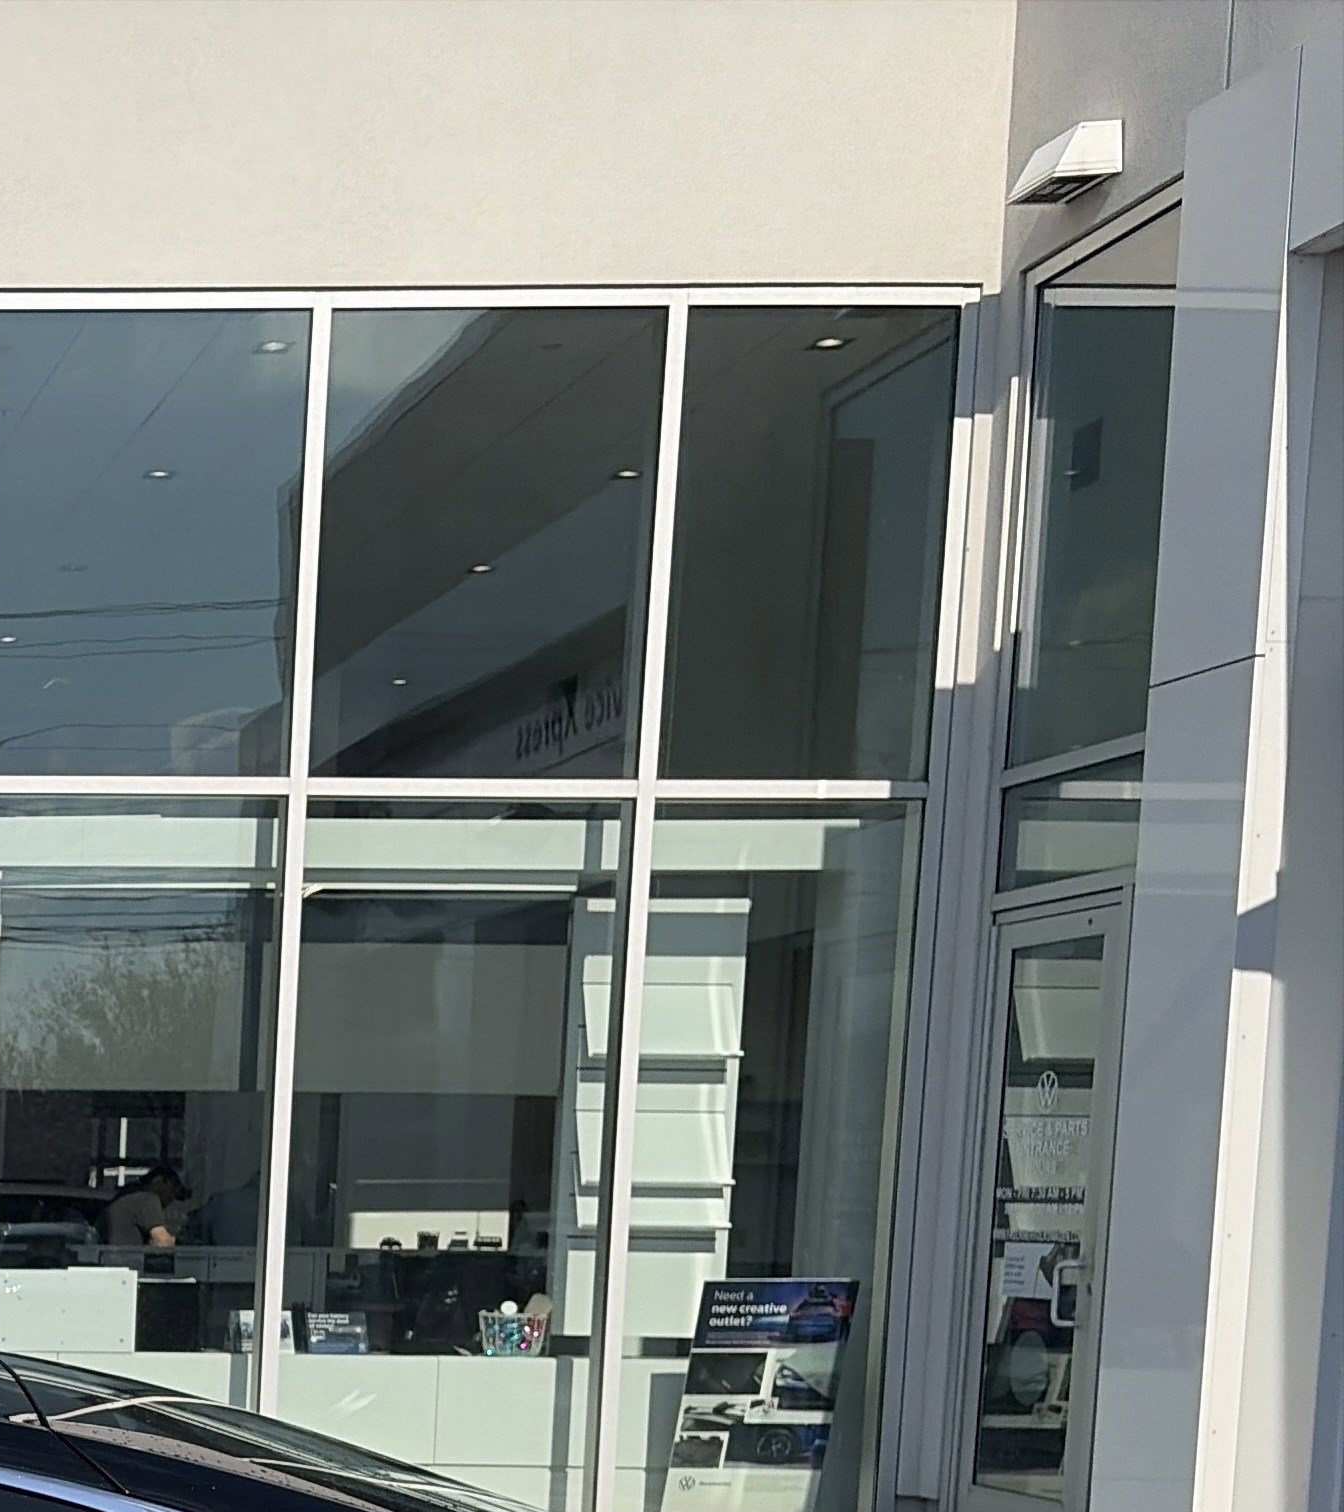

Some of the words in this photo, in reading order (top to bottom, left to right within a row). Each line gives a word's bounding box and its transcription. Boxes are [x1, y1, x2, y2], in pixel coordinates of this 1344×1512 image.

[714, 1290, 744, 1301] Need
[746, 1291, 754, 1301] a
[711, 1304, 737, 1314] new
[739, 1302, 787, 1314] creative
[708, 1315, 753, 1327] outlet?
